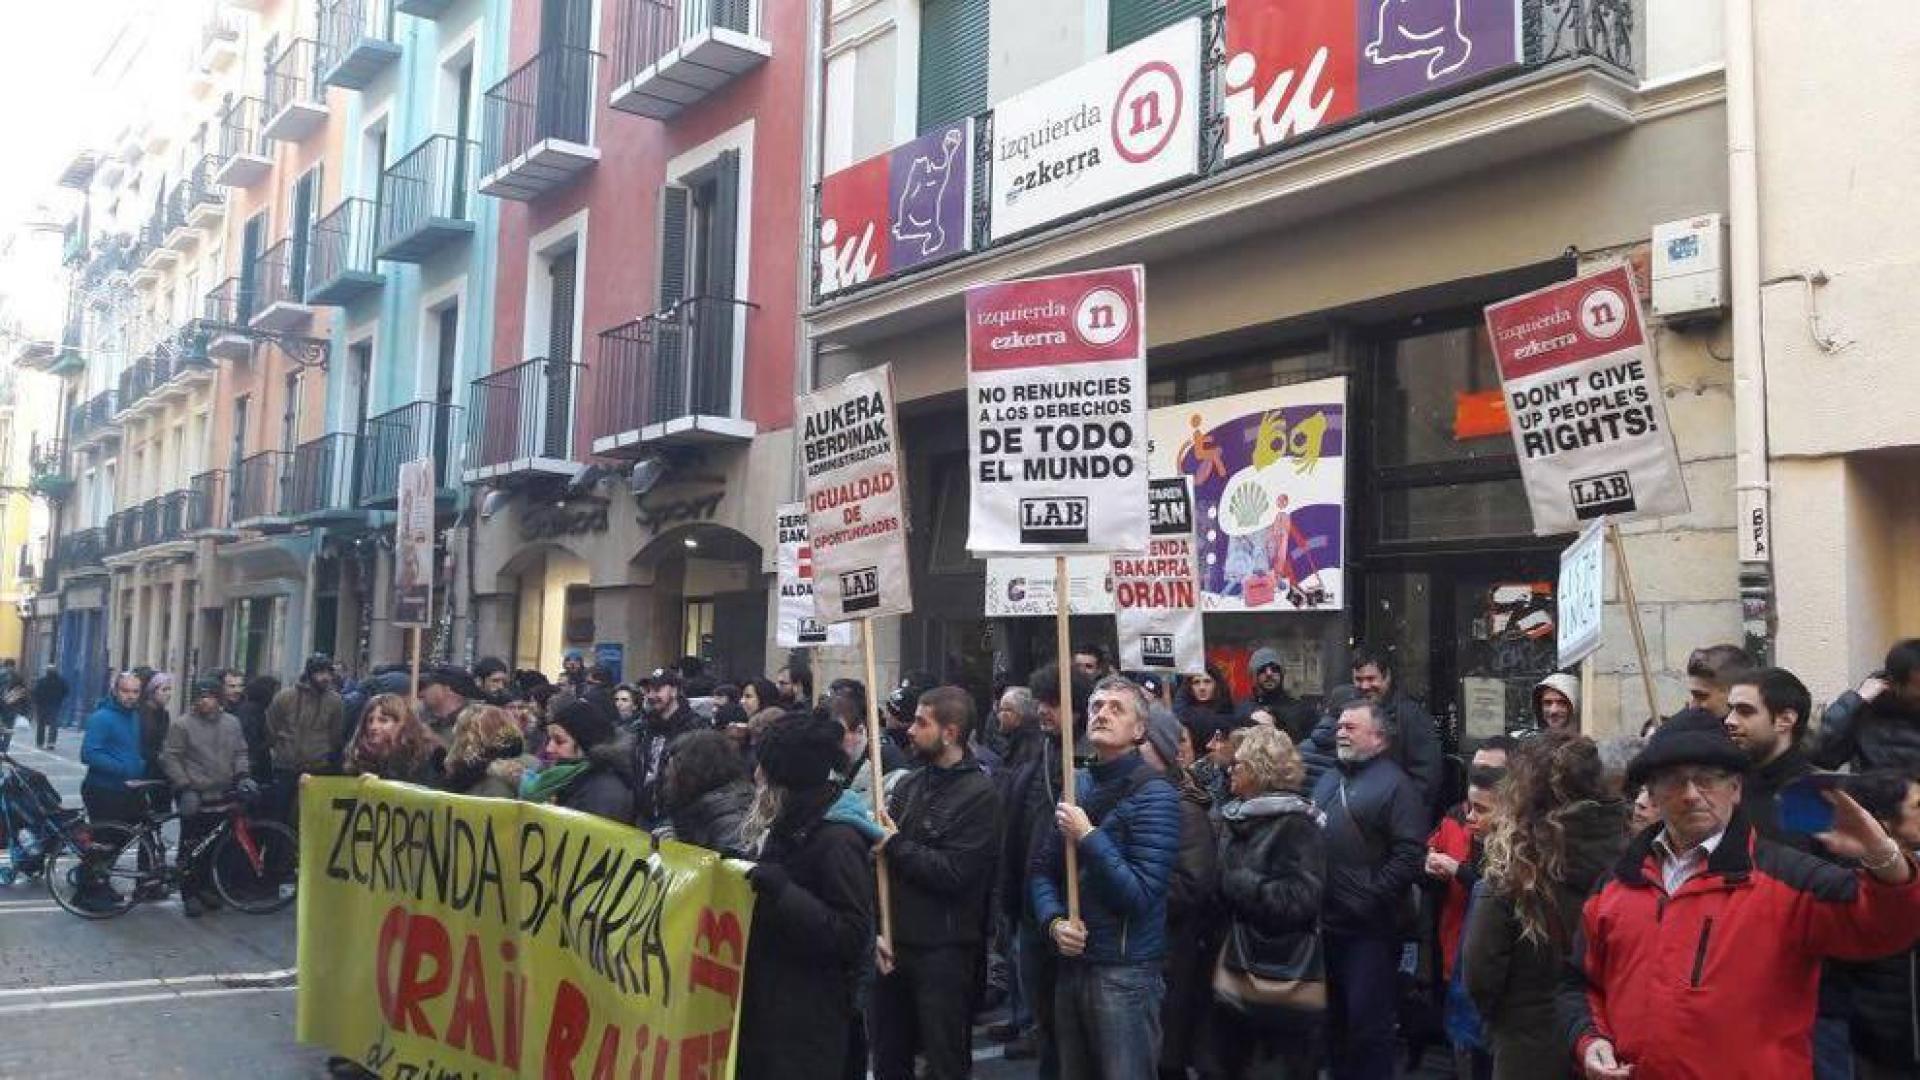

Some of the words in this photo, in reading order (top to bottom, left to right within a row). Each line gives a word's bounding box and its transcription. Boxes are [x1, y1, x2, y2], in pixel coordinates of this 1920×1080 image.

[998, 102, 1103, 163] izquierda
[1006, 147, 1102, 203] ezkerra
[977, 299, 1066, 327] izquierda
[1498, 306, 1572, 341] izquierda
[991, 330, 1066, 350] ezkerra
[1514, 331, 1578, 361] ezkerra
[978, 386, 1006, 405] NO
[1012, 376, 1133, 402] RENUNCIES
[1512, 377, 1580, 411] DON'T
[1589, 360, 1646, 392] GIVE
[805, 390, 885, 441] AUKERA
[980, 409, 990, 422] A
[996, 406, 1029, 421] LOS
[1034, 398, 1133, 419] DERECHOS
[1518, 411, 1543, 431] UP
[1550, 386, 1649, 425] PEOPLE'S
[805, 418, 888, 465] BERDINAK
[979, 427, 1023, 455] DE
[1034, 420, 1134, 452] TODO
[1523, 404, 1658, 459] RIGHTS!
[979, 460, 1013, 483] EL
[1023, 453, 1134, 481] MUNDO
[810, 471, 894, 513] IGUALDAD
[1575, 475, 1629, 505] LAB
[843, 505, 863, 525] DE
[1023, 501, 1084, 527] LAB
[1113, 558, 1191, 577] BAKARRA
[840, 571, 877, 600] LAB
[1117, 580, 1194, 609] ORAIN
[1143, 636, 1173, 653] LAB
[326, 797, 507, 924] ZERRENDA
